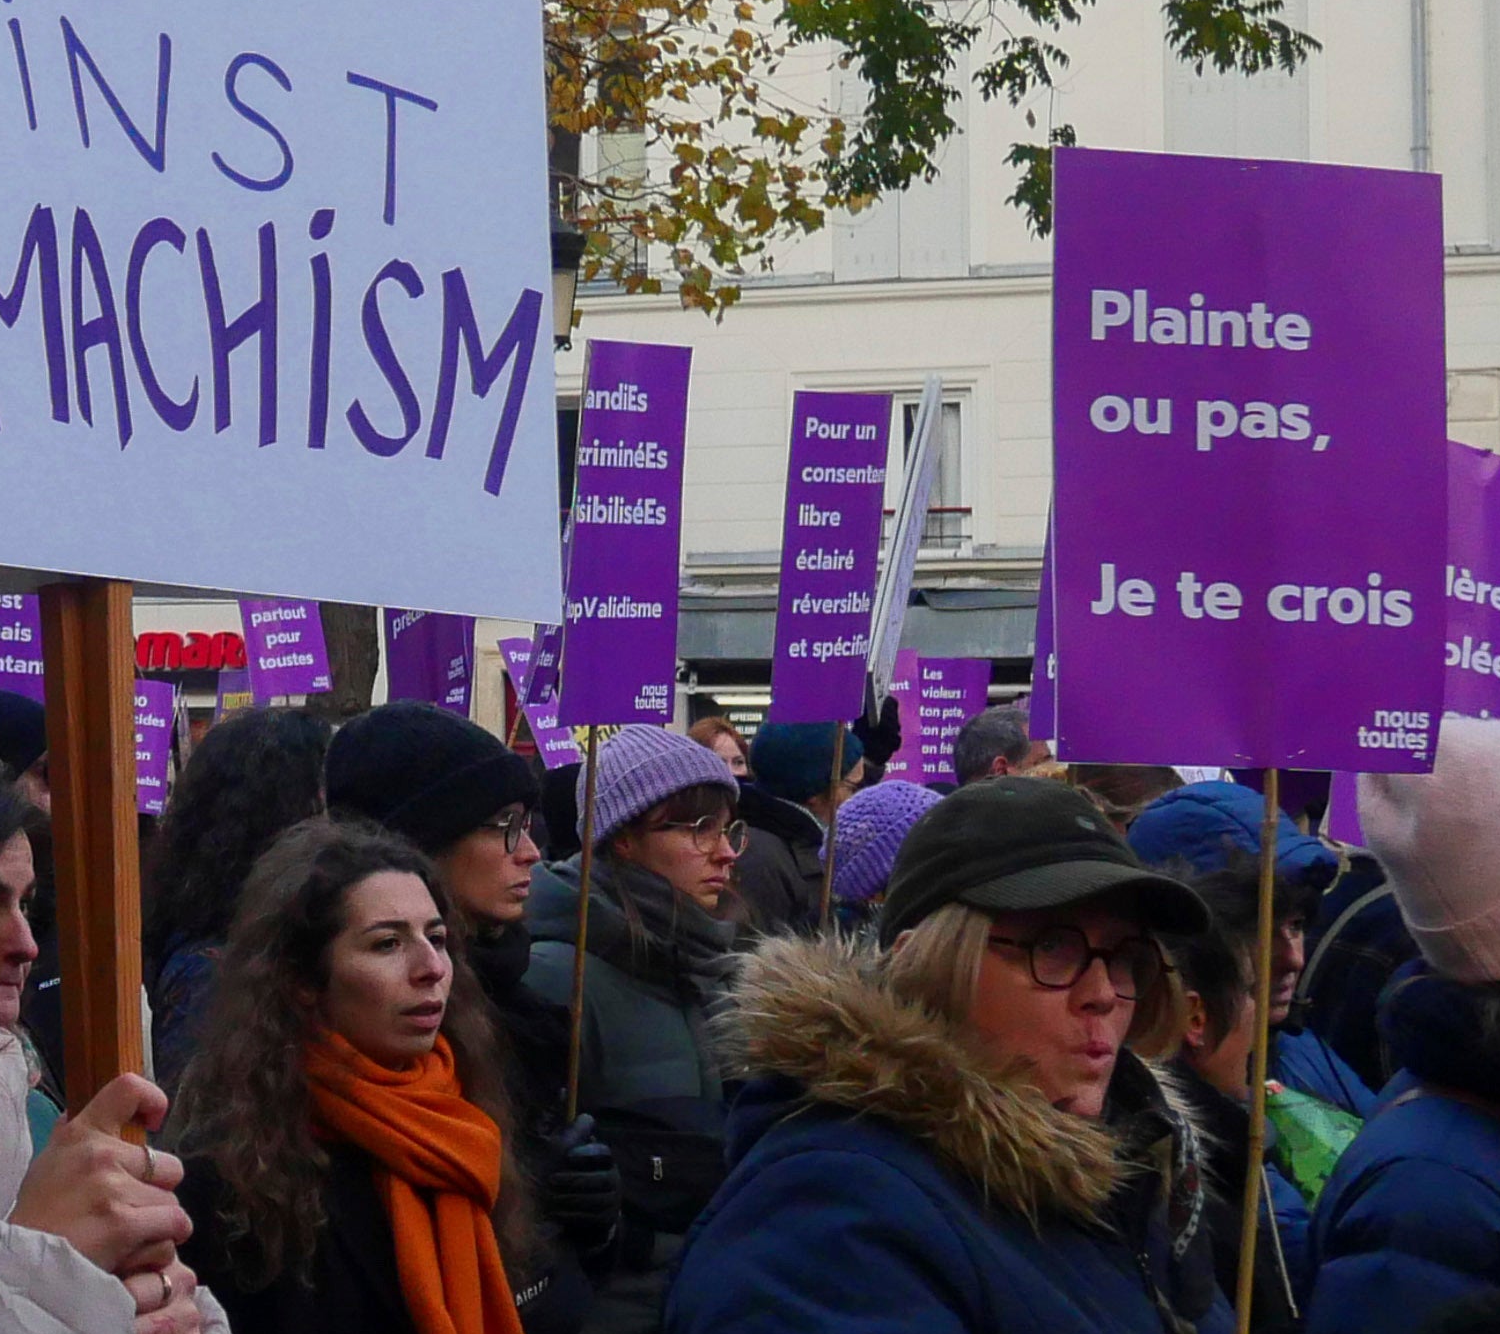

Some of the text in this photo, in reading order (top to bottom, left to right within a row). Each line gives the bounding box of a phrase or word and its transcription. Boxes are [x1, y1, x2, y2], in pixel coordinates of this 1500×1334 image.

[1091, 289, 1311, 351] Plainte
[806, 417, 876, 440] Pour un
[1089, 395, 1331, 451] ou pas,
[799, 504, 841, 526] libre
[796, 548, 854, 570] éclairé
[1090, 563, 1413, 627] Je te crois
[251, 606, 306, 627] partout
[266, 631, 301, 649] pour
[789, 639, 807, 657] et
[259, 652, 314, 670] toustes
[923, 667, 943, 680] Les
[642, 685, 668, 696] nous
[635, 695, 667, 709] toutes
[1374, 709, 1430, 729] nous
[1357, 727, 1428, 751] toutes
